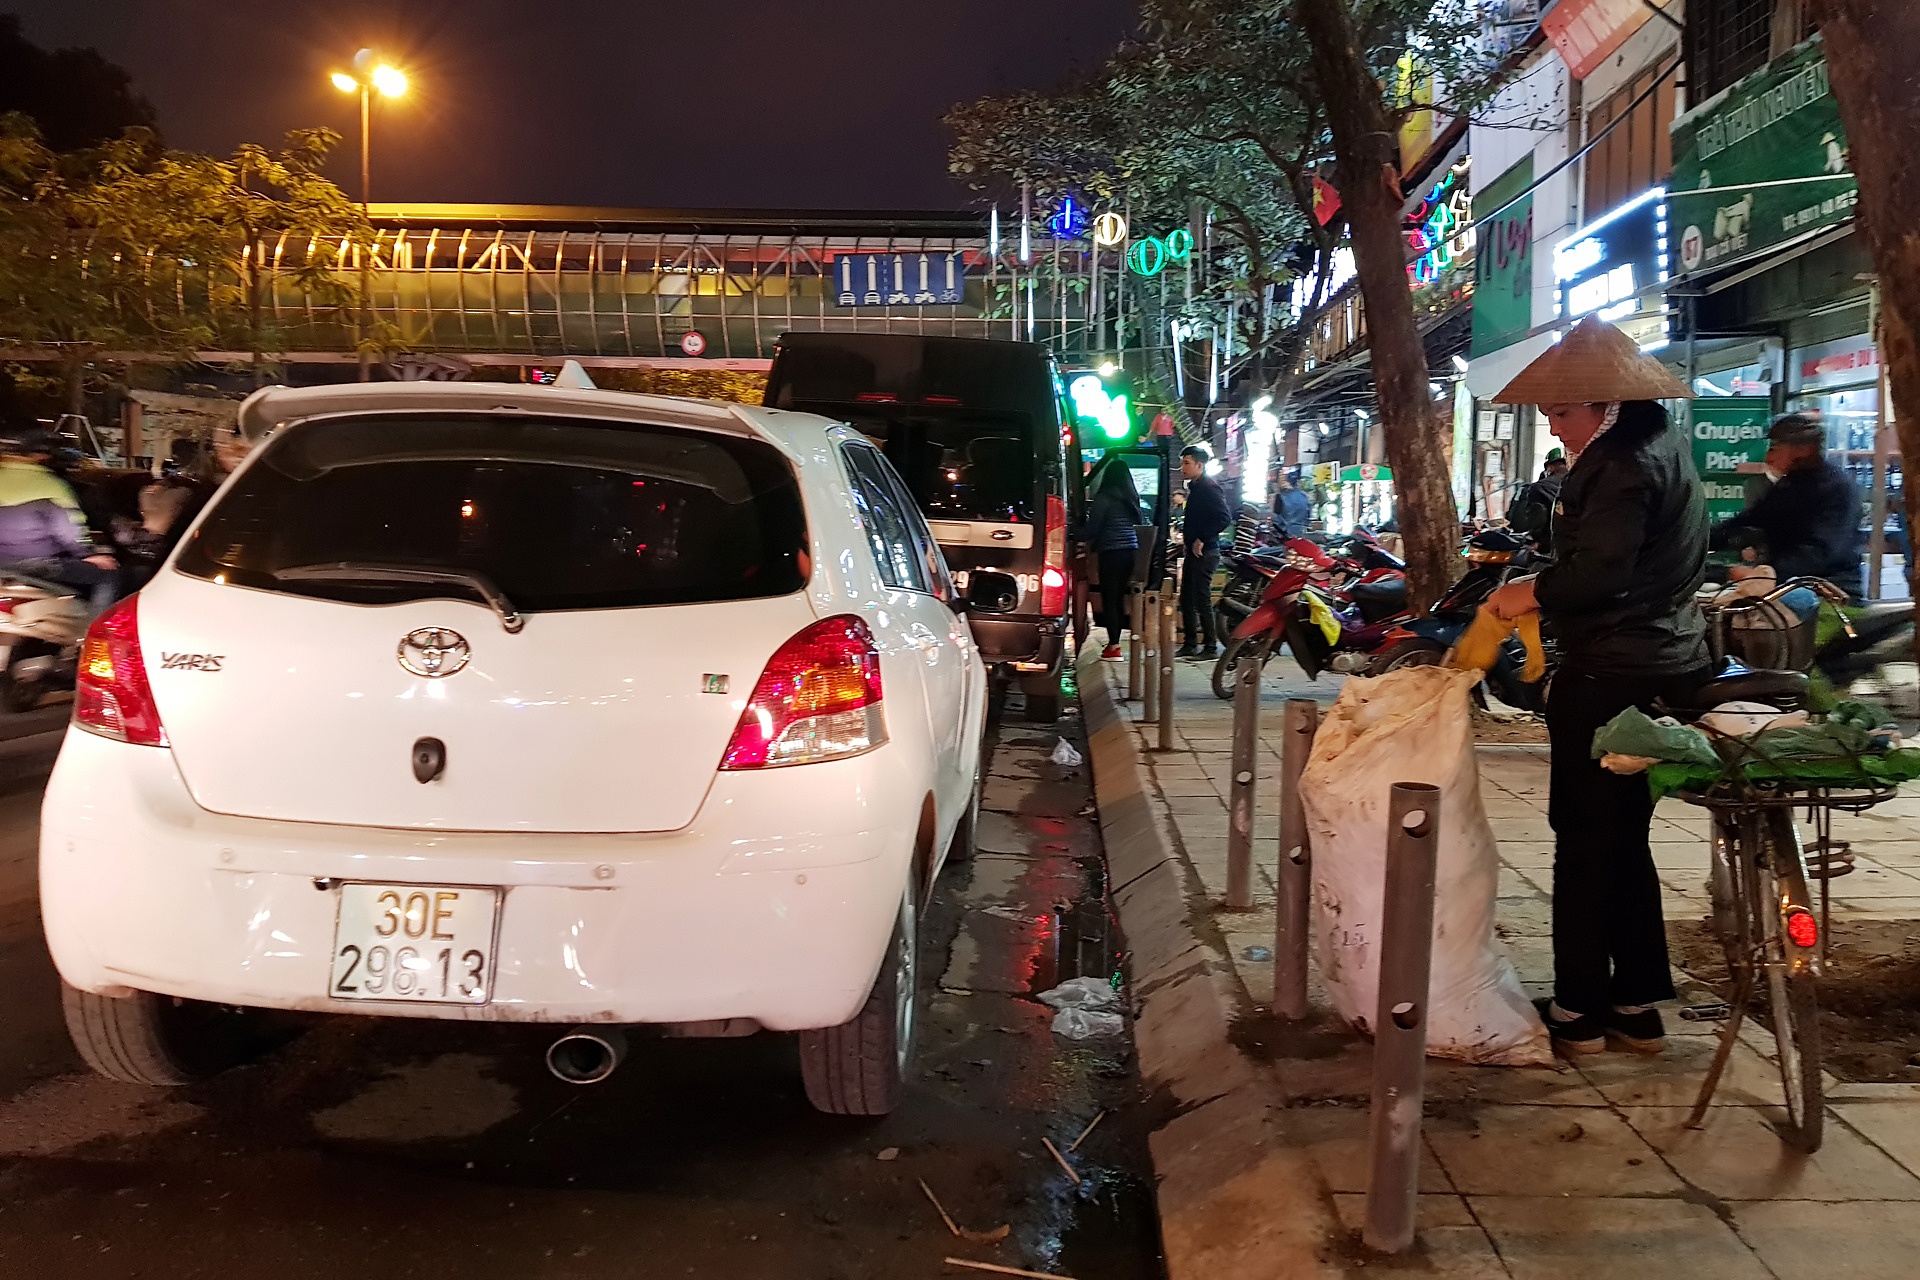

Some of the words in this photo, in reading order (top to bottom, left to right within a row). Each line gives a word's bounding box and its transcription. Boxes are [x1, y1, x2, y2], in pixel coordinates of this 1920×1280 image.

[1694, 418, 1765, 443] Chuyển
[1705, 451, 1749, 470] Phát
[161, 651, 226, 672] YARIS
[375, 890, 459, 942] 30E
